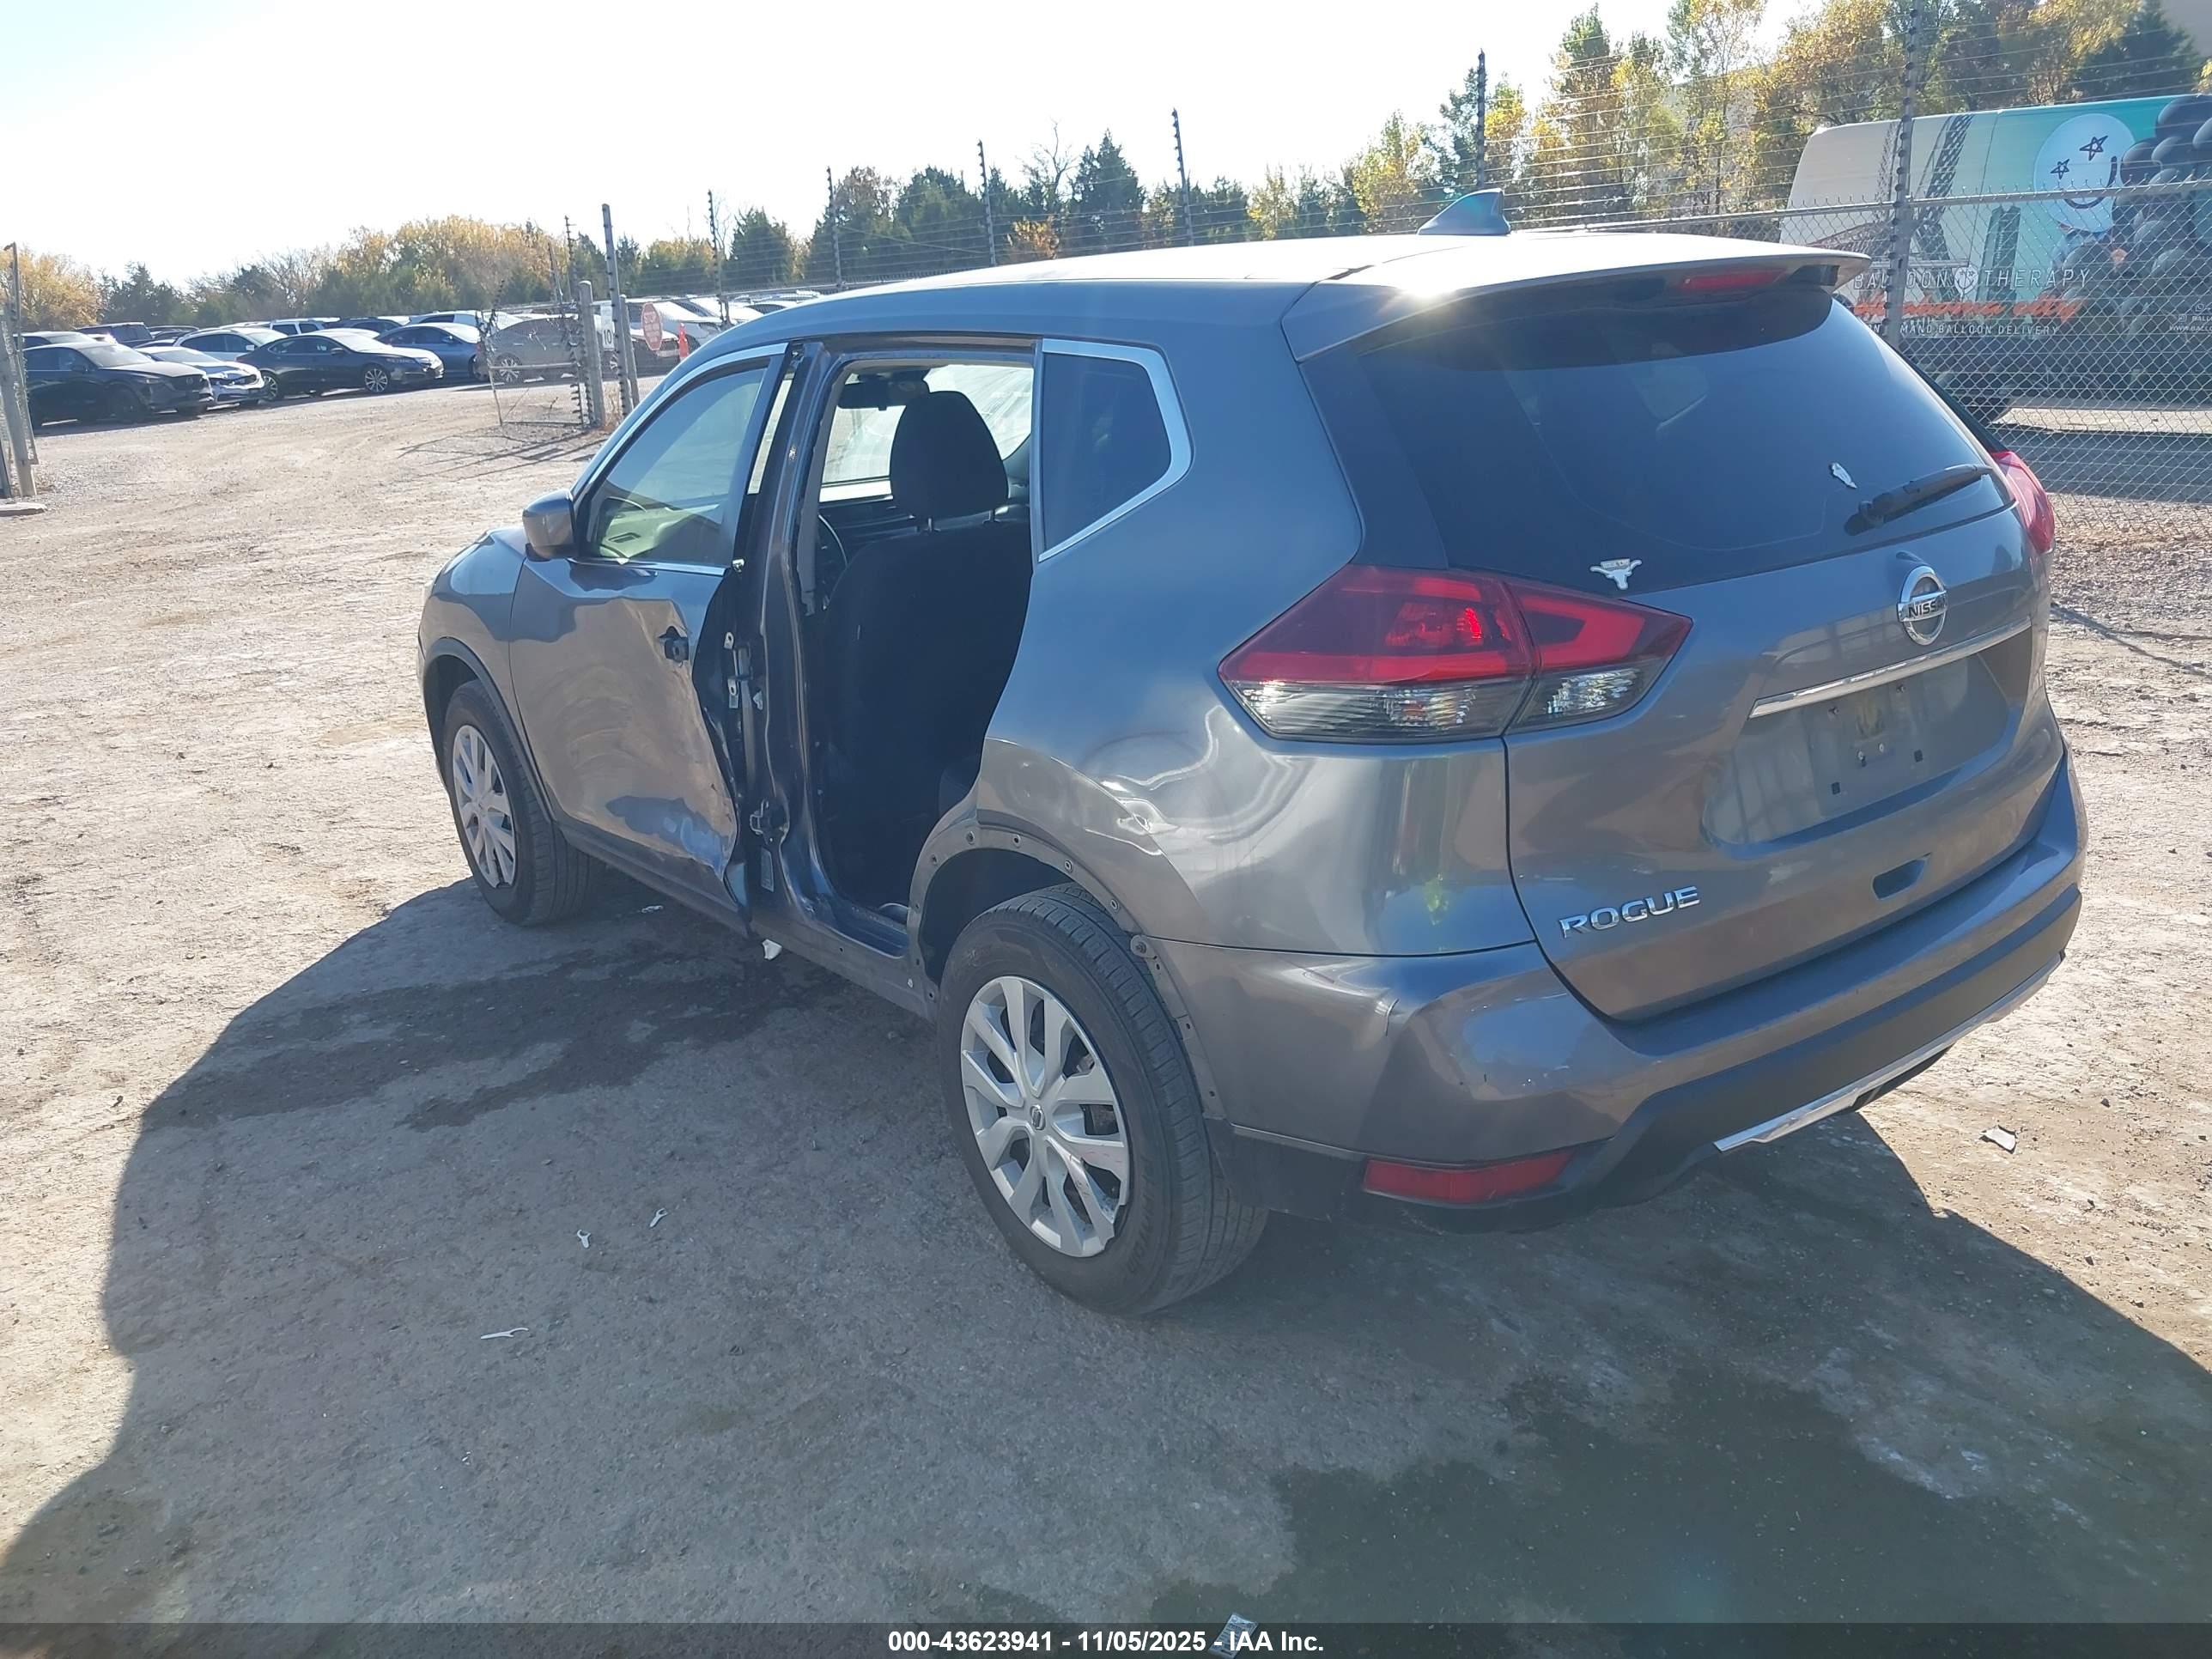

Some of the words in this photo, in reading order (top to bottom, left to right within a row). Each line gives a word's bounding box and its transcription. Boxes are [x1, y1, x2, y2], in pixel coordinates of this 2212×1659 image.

[1855, 271, 1948, 289] BALOON
[1984, 269, 2090, 287] THERAPY
[604, 329, 611, 344] 10
[1938, 323, 1992, 334] BALLOON
[1998, 325, 2059, 336] DELIVERY
[1908, 596, 1943, 618] NISS
[1559, 885, 1700, 939] ROGUE
